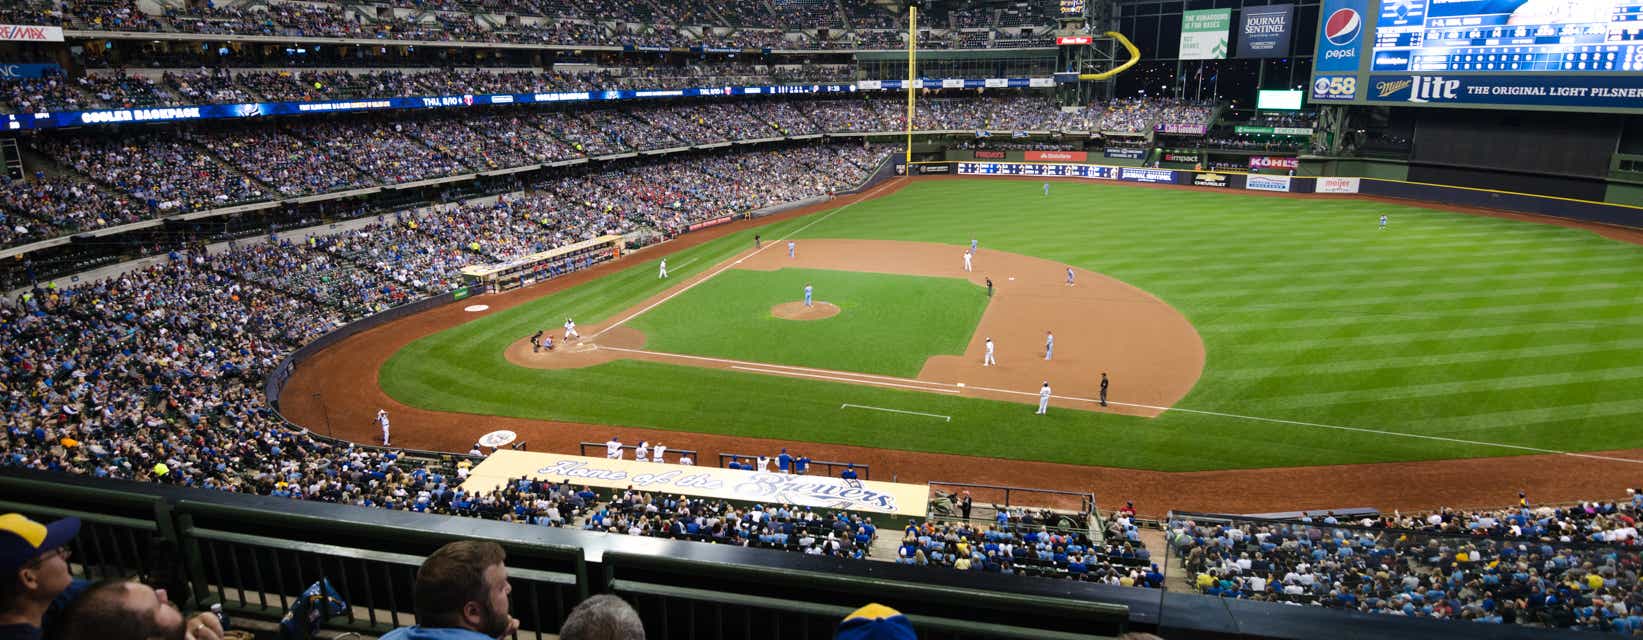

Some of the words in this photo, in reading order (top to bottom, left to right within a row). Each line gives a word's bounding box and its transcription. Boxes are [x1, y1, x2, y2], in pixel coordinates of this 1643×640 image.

[1247, 16, 1286, 26] JOURNAL
[1245, 25, 1285, 33] SENTINEL
[1325, 48, 1355, 59] pepsi
[1329, 77, 1355, 95] 58
[1376, 80, 1412, 97] Miller
[1408, 75, 1460, 103] Lite
[1467, 86, 1490, 95] THE
[1492, 86, 1546, 96] ORIGINAL
[1549, 87, 1588, 97] LIGHT
[1590, 88, 1643, 98] PILSNER
[82, 110, 133, 123] COOLER
[134, 107, 200, 120] BACKPACK
[1164, 124, 1176, 133] Club
[1171, 154, 1197, 163] impact
[1325, 178, 1350, 187] meijer
[538, 460, 627, 480] Home
[632, 470, 682, 487] of
[675, 474, 723, 489] the
[734, 473, 897, 511] Brewers
